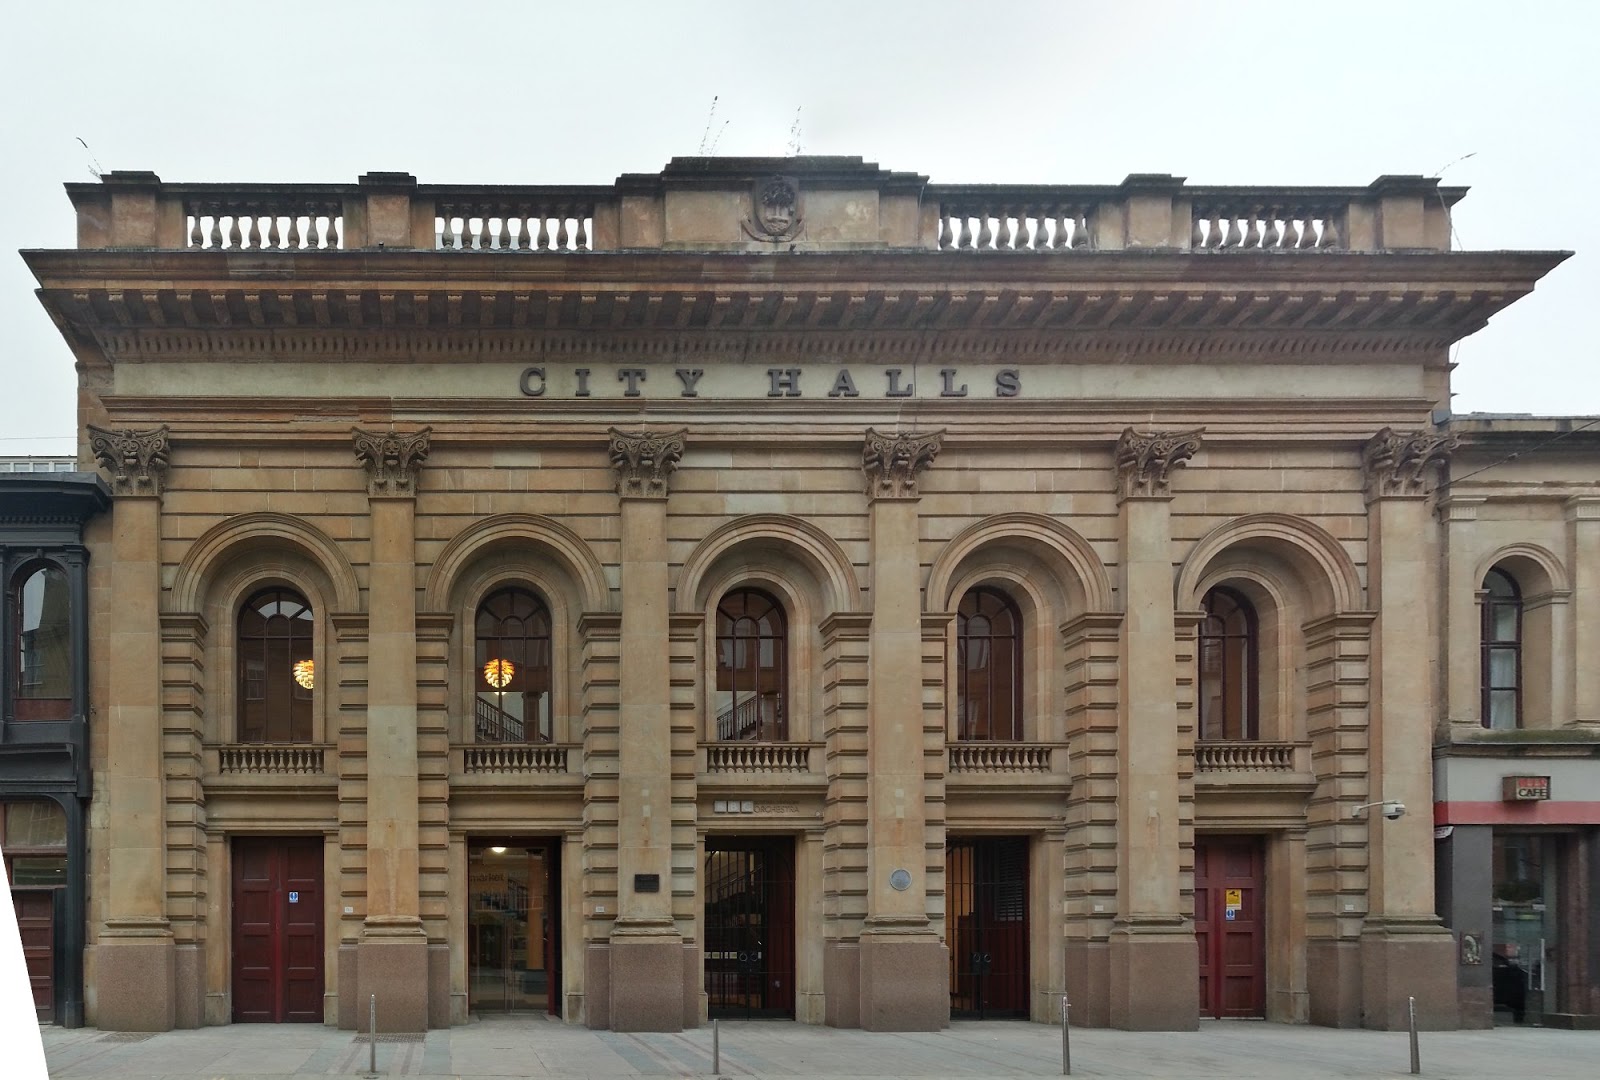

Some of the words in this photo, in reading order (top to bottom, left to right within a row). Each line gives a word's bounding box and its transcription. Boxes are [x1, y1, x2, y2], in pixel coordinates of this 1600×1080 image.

[519, 367, 703, 397] CITY
[766, 368, 1022, 397] HALLS
[753, 805, 800, 814] ORCHESTRA
